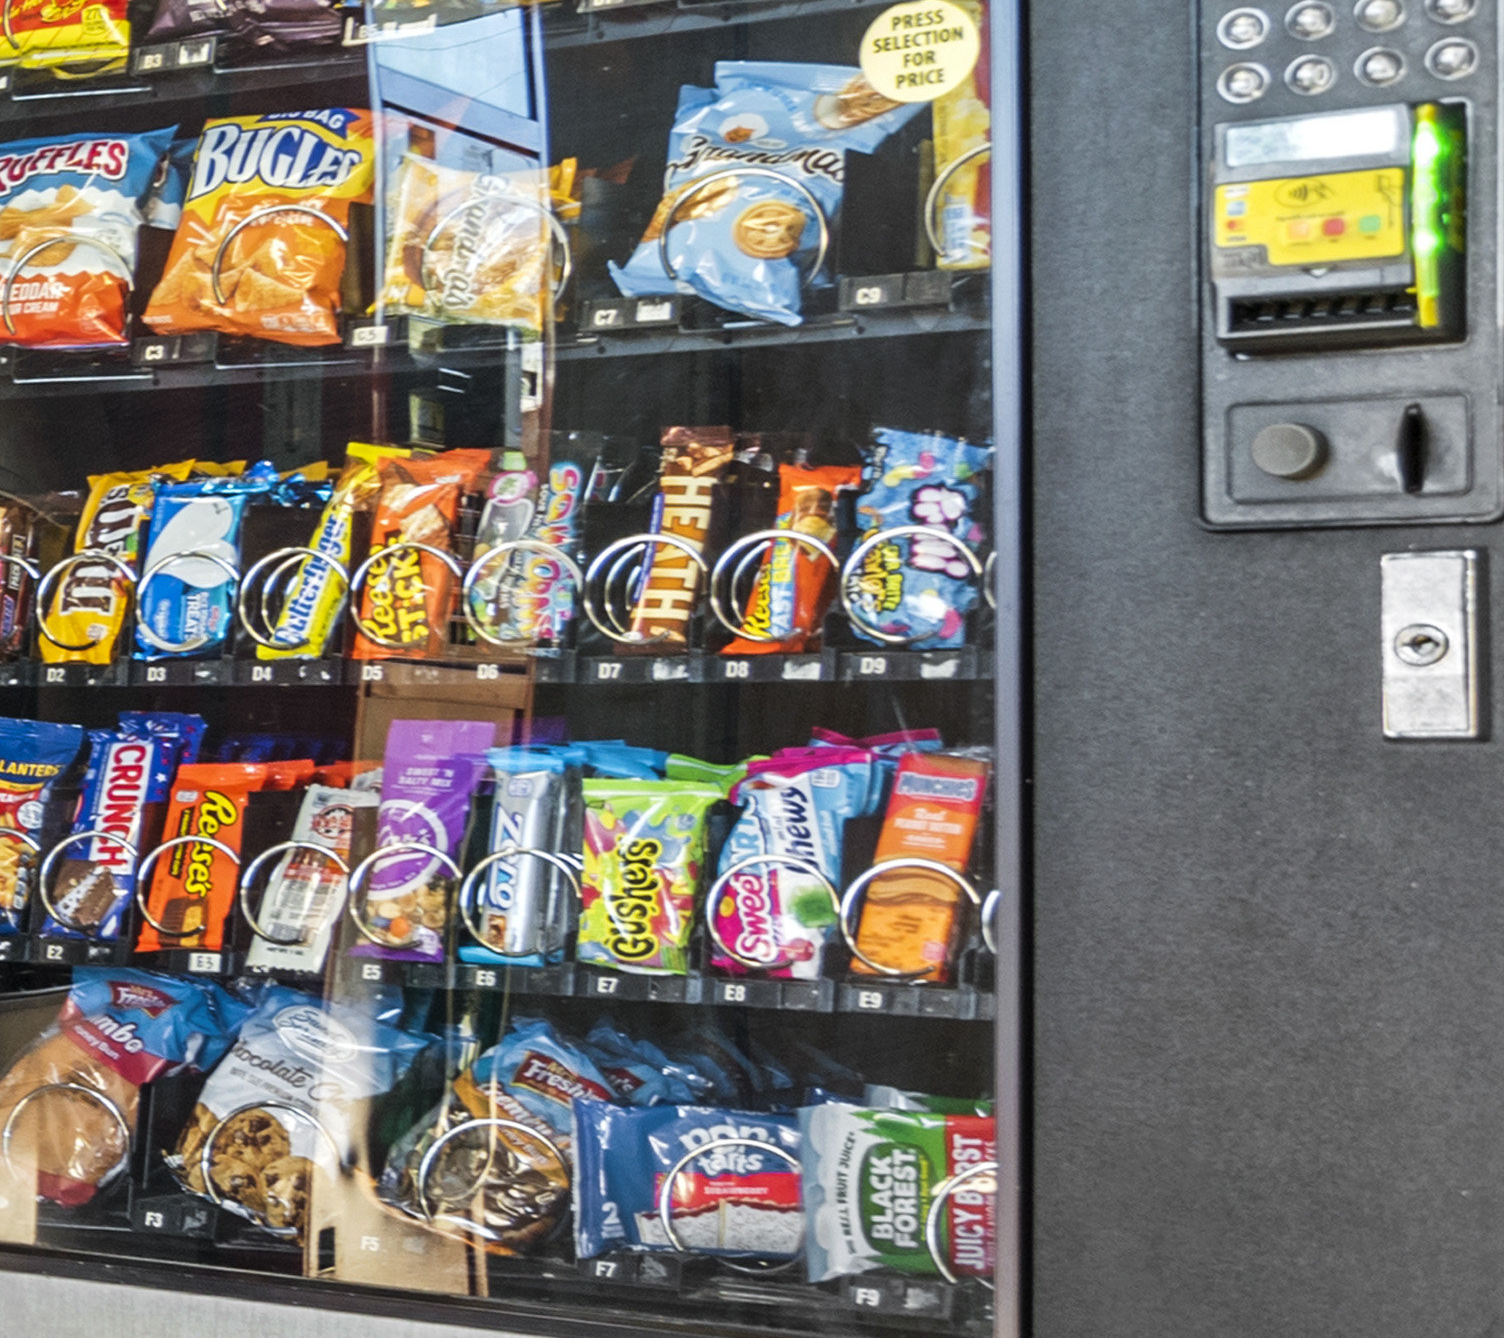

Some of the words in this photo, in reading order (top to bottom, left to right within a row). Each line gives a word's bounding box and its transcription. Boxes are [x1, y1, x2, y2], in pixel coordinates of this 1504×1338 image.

[890, 8, 946, 31] PRESS
[873, 25, 965, 54] SELECTION
[902, 50, 937, 69] FOR
[895, 67, 947, 90] PRICE
[303, 107, 347, 131] BAG
[190, 121, 363, 200] BUGLES
[148, 667, 167, 683] D3
[92, 741, 148, 868] CRUNCH
[724, 986, 747, 1003] E8
[869, 1154, 892, 1240] BLACK
[145, 1211, 163, 1228] F3
[953, 1202, 984, 1271] JUICY
